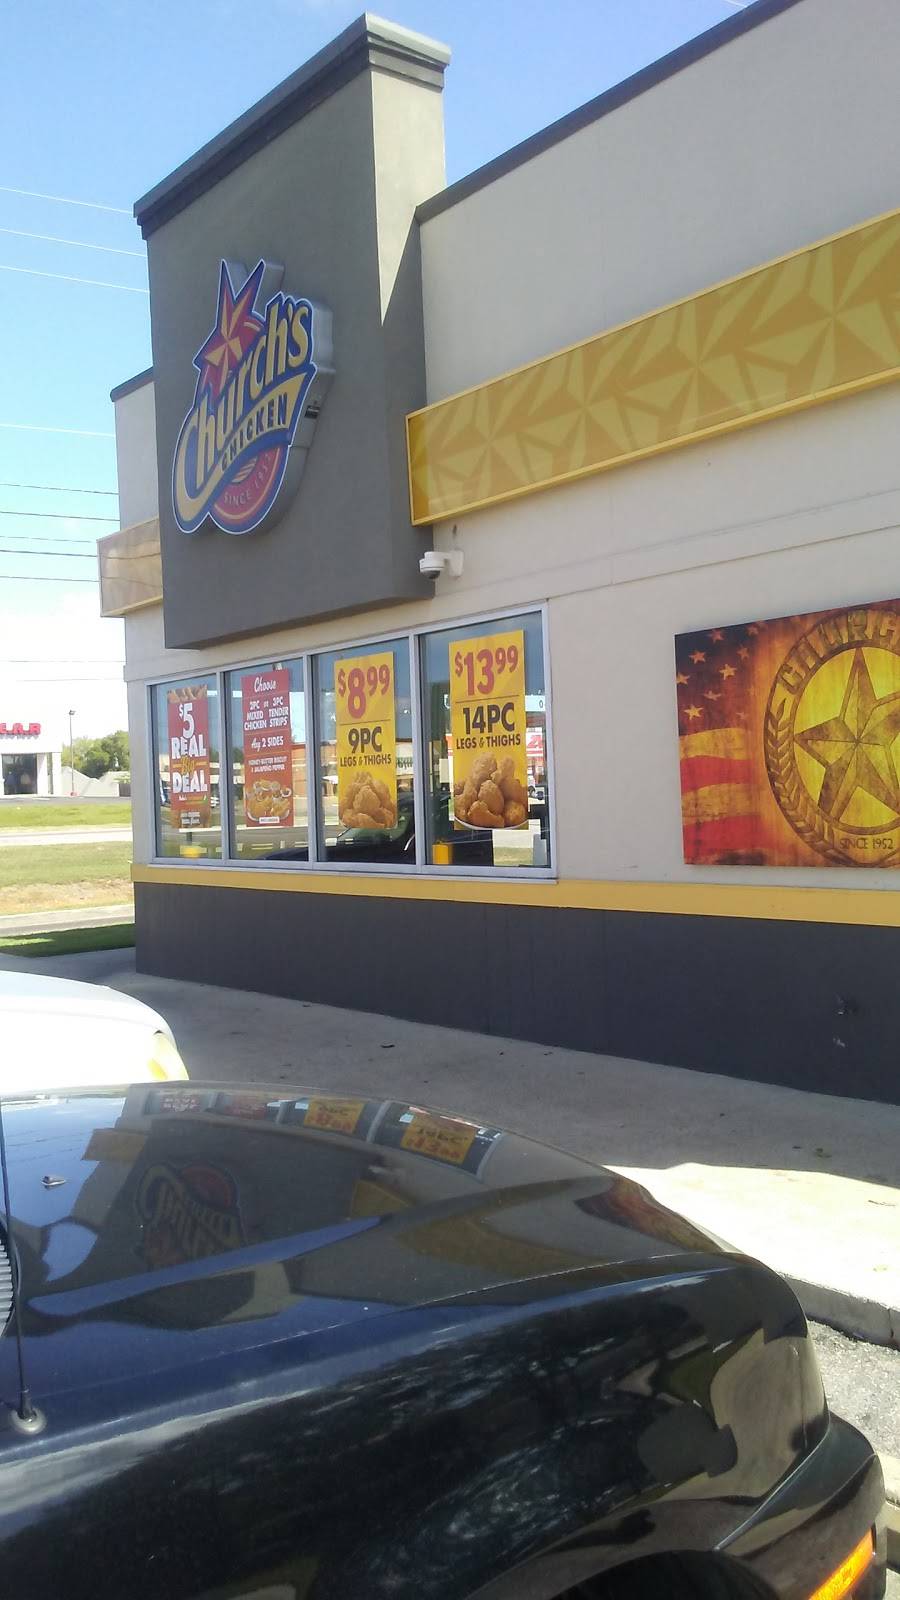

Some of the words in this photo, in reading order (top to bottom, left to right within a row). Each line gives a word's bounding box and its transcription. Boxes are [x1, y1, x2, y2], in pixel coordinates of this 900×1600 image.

[176, 303, 309, 522] Church's
[221, 391, 288, 472] CHICKEN
[224, 489, 251, 506] SINCE
[778, 608, 900, 694] CHURC
[254, 677, 277, 693] Choose
[272, 696, 284, 707] 3PC
[179, 702, 195, 739] $5
[269, 706, 289, 718] TENDER
[462, 702, 516, 735] 14PC
[244, 719, 267, 731] CHICKEN
[269, 716, 288, 728] STRIPS
[171, 734, 207, 760] REAL
[262, 738, 267, 747] 2
[267, 736, 284, 746] SIDES
[348, 726, 382, 754] 9PC
[456, 737, 477, 750] LEGS
[479, 737, 484, 748] &
[486, 734, 521, 747] THIGHS
[340, 755, 357, 768] LEGS
[363, 754, 392, 766] THIGHS
[172, 770, 208, 794] DEAL
[839, 837, 868, 850] SINCE
[871, 838, 894, 850] 1952
